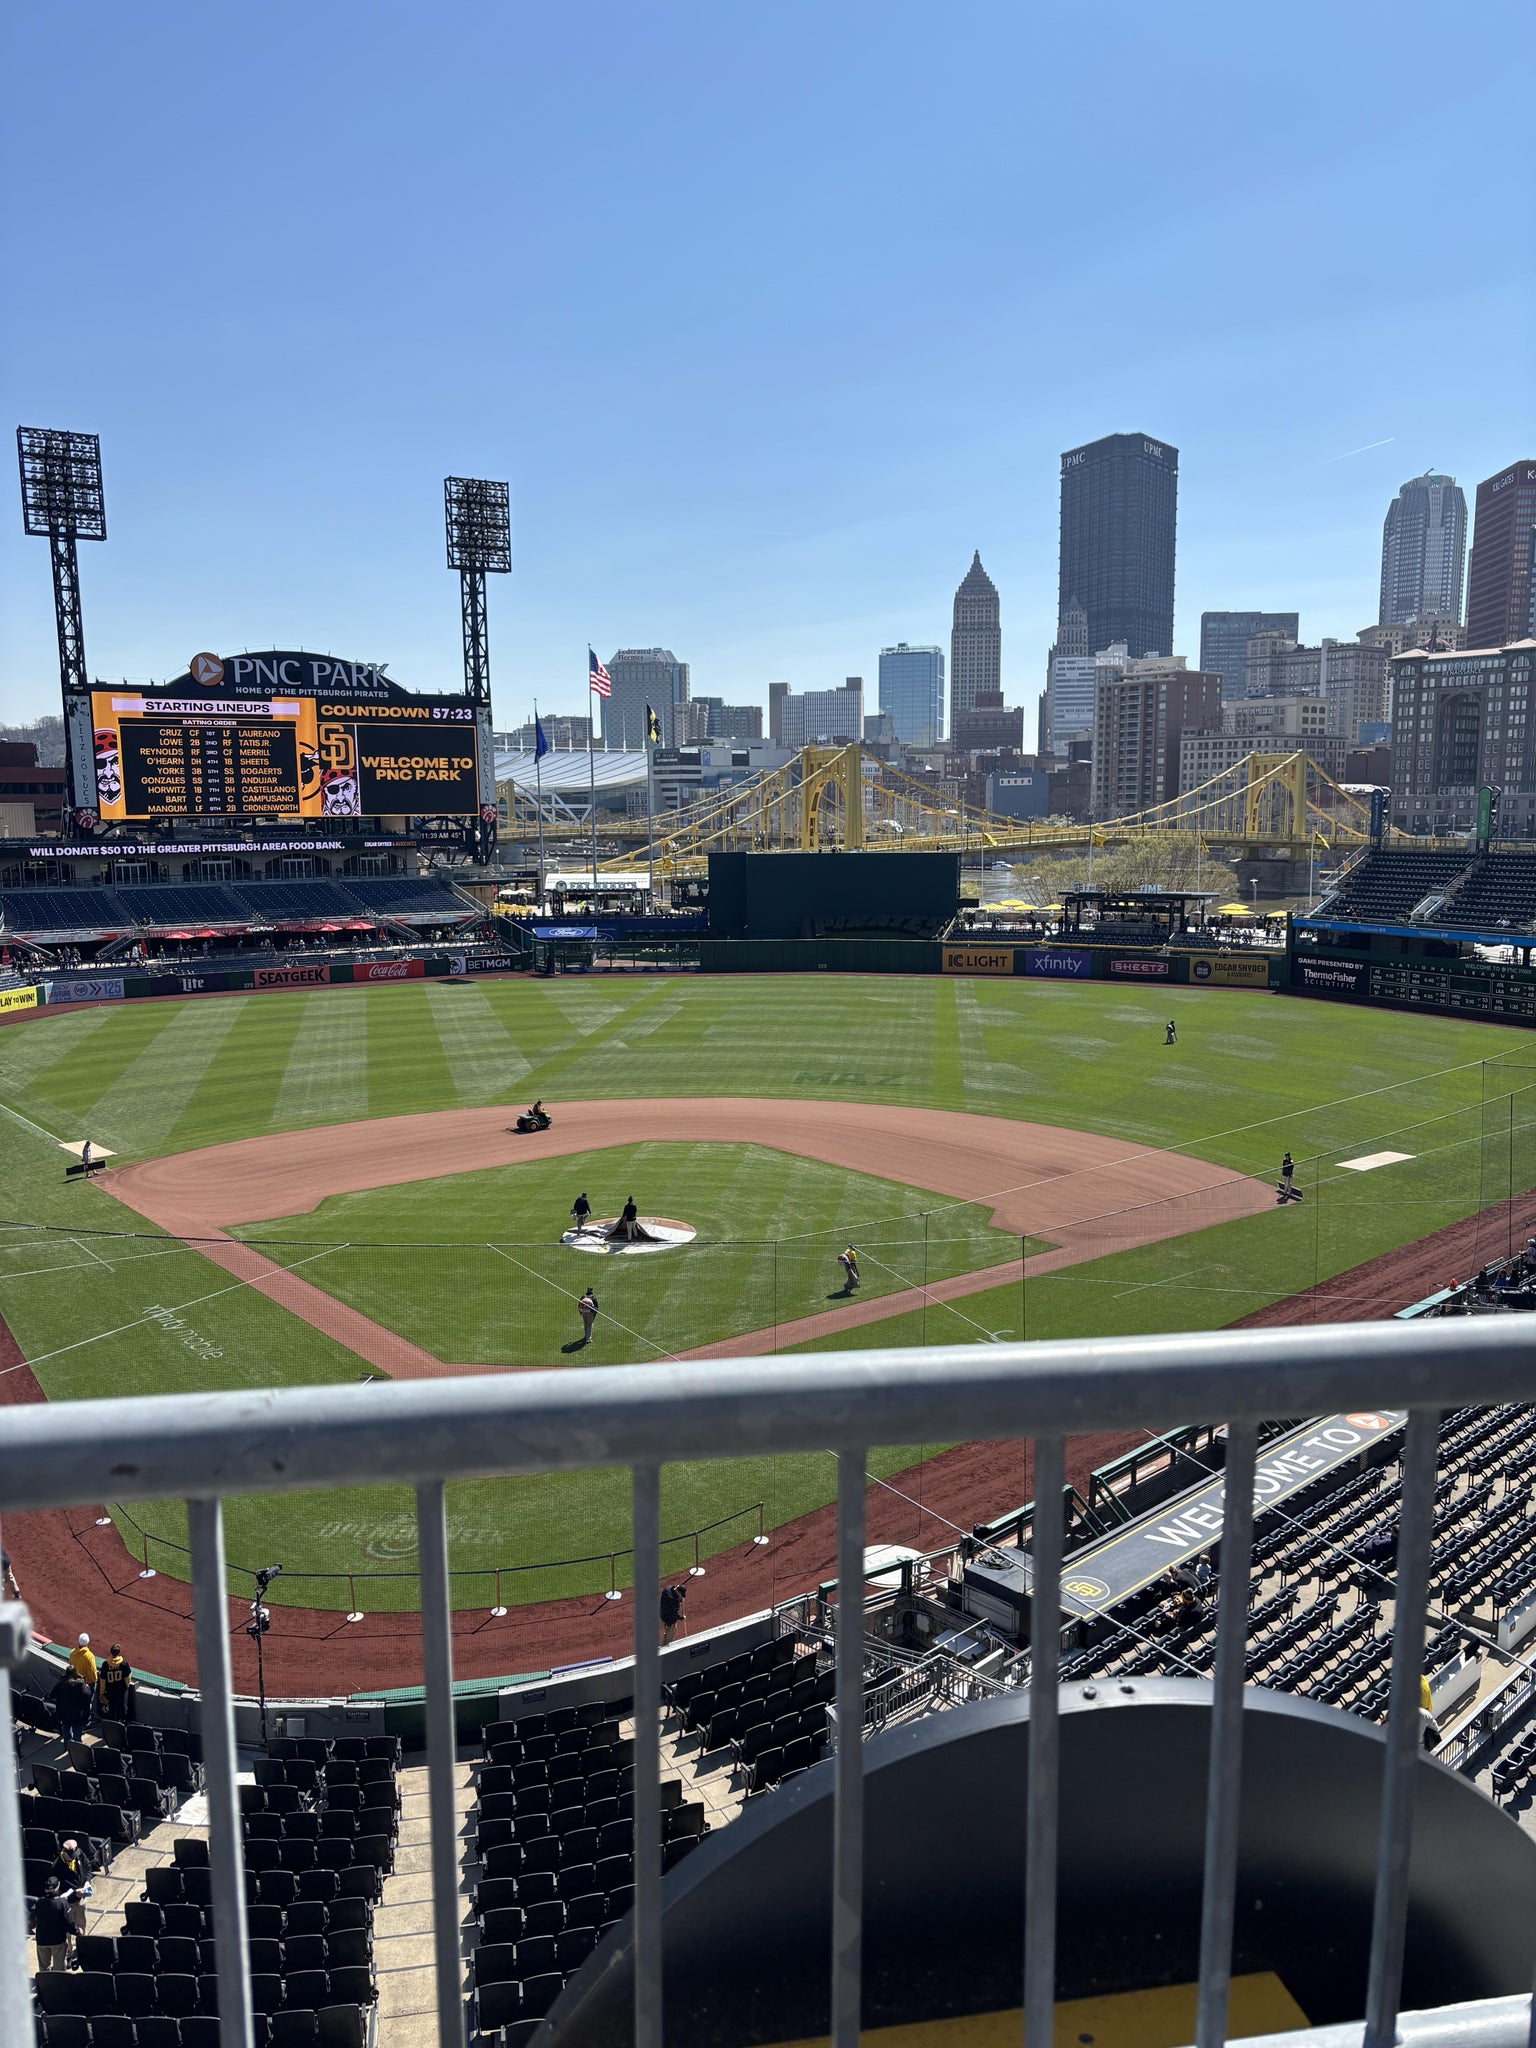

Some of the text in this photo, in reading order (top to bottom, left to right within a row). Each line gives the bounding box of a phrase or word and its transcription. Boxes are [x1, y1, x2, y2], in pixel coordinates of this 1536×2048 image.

[1144, 441, 1164, 458] UPMC
[230, 657, 389, 689] PNC PARK
[236, 686, 389, 698] HOME OF THE PITTSBURGH PIRATES
[145, 701, 270, 713] STARTING LINEUPS
[320, 705, 473, 720] COUNTDOWN 57:23
[159, 729, 183, 737] CRUZ
[189, 729, 199, 737] CF
[238, 730, 280, 738] LAUREANO
[159, 738, 183, 746] LOWE
[190, 738, 201, 746] 2B
[223, 739, 233, 747] RF
[239, 739, 260, 747] TATIS
[261, 739, 272, 747] JR.
[319, 724, 355, 770] SD
[140, 748, 184, 756] REYNOLDS
[191, 748, 201, 756] RF
[147, 757, 184, 766] O'HEARN
[191, 758, 202, 766] DH
[224, 758, 233, 766] 1B
[240, 758, 270, 766] SHEETS
[361, 756, 473, 769] WELCOME TO
[157, 767, 185, 775] YORKE
[191, 767, 202, 775] 3B
[224, 767, 235, 775] SS
[240, 767, 283, 775] BOGAERTS
[375, 769, 462, 781] PNC PARK
[141, 777, 186, 785] GONZALES
[192, 777, 203, 785] SS
[225, 777, 235, 785] 3B
[148, 786, 187, 794] HORWITZ
[194, 786, 203, 794] 1B
[225, 786, 236, 794] DH
[166, 795, 187, 803] BART
[196, 795, 202, 803] C
[228, 795, 234, 803] C
[148, 805, 187, 813] MANGUM
[243, 804, 298, 812] CRONENWORTH
[30, 840, 345, 857] WILL DONATE $50 TO THE GREATER PITTSBURGH AREA FOOD BANK.
[555, 928, 577, 937] Ford
[468, 958, 511, 970] BETMGM
[948, 954, 1008, 967] IC LIGHT
[1035, 954, 1082, 973] xfinity
[1298, 957, 1317, 966] GAME
[1317, 960, 1354, 969] PRESENTED
[369, 962, 409, 979] Coca-Cola
[1115, 962, 1165, 972] SHEETZ
[1215, 963, 1266, 973] EDGAR SNYDER
[1465, 963, 1491, 971] WELCOME
[259, 967, 324, 985] SEATGEEK
[103, 981, 121, 995] 125
[183, 977, 204, 991] Lite
[1304, 978, 1355, 990] SCIENTIFIC
[0, 998, 13, 1007] LAY
[19, 993, 35, 1003] WIN!
[1302, 1428, 1362, 1453] TO
[107, 1670, 122, 1683] 00
